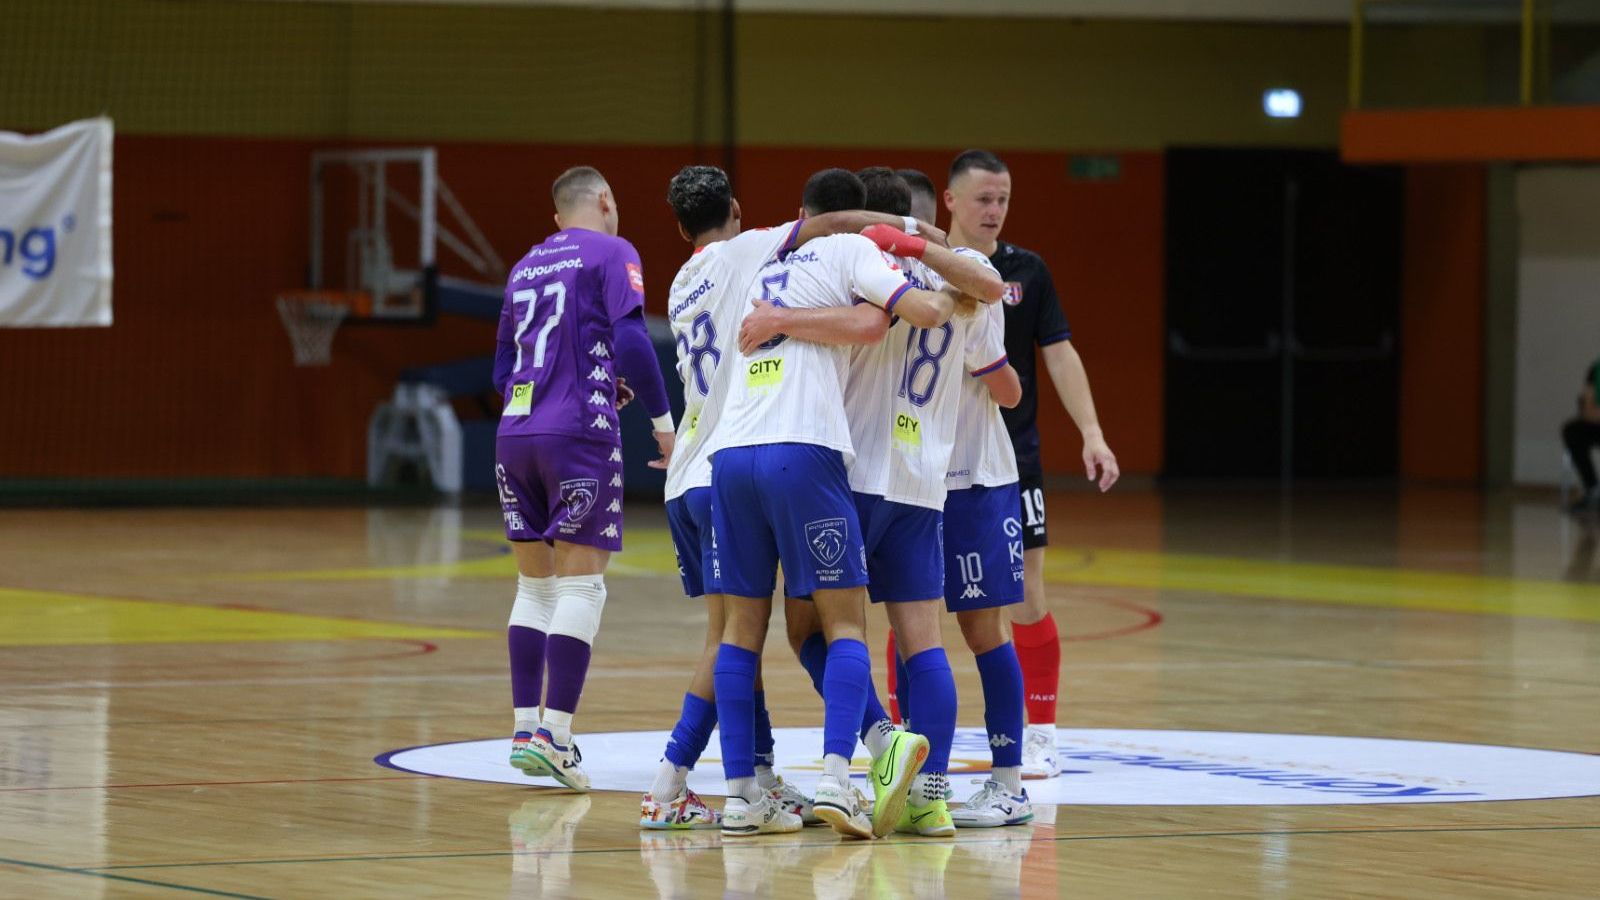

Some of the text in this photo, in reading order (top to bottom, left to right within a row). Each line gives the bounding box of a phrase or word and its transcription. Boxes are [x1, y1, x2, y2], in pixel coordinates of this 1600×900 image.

[512, 281, 567, 374] 77
[749, 359, 782, 375] CITY
[898, 320, 954, 408] 18
[1021, 488, 1046, 526] 19
[956, 552, 983, 584] 10
